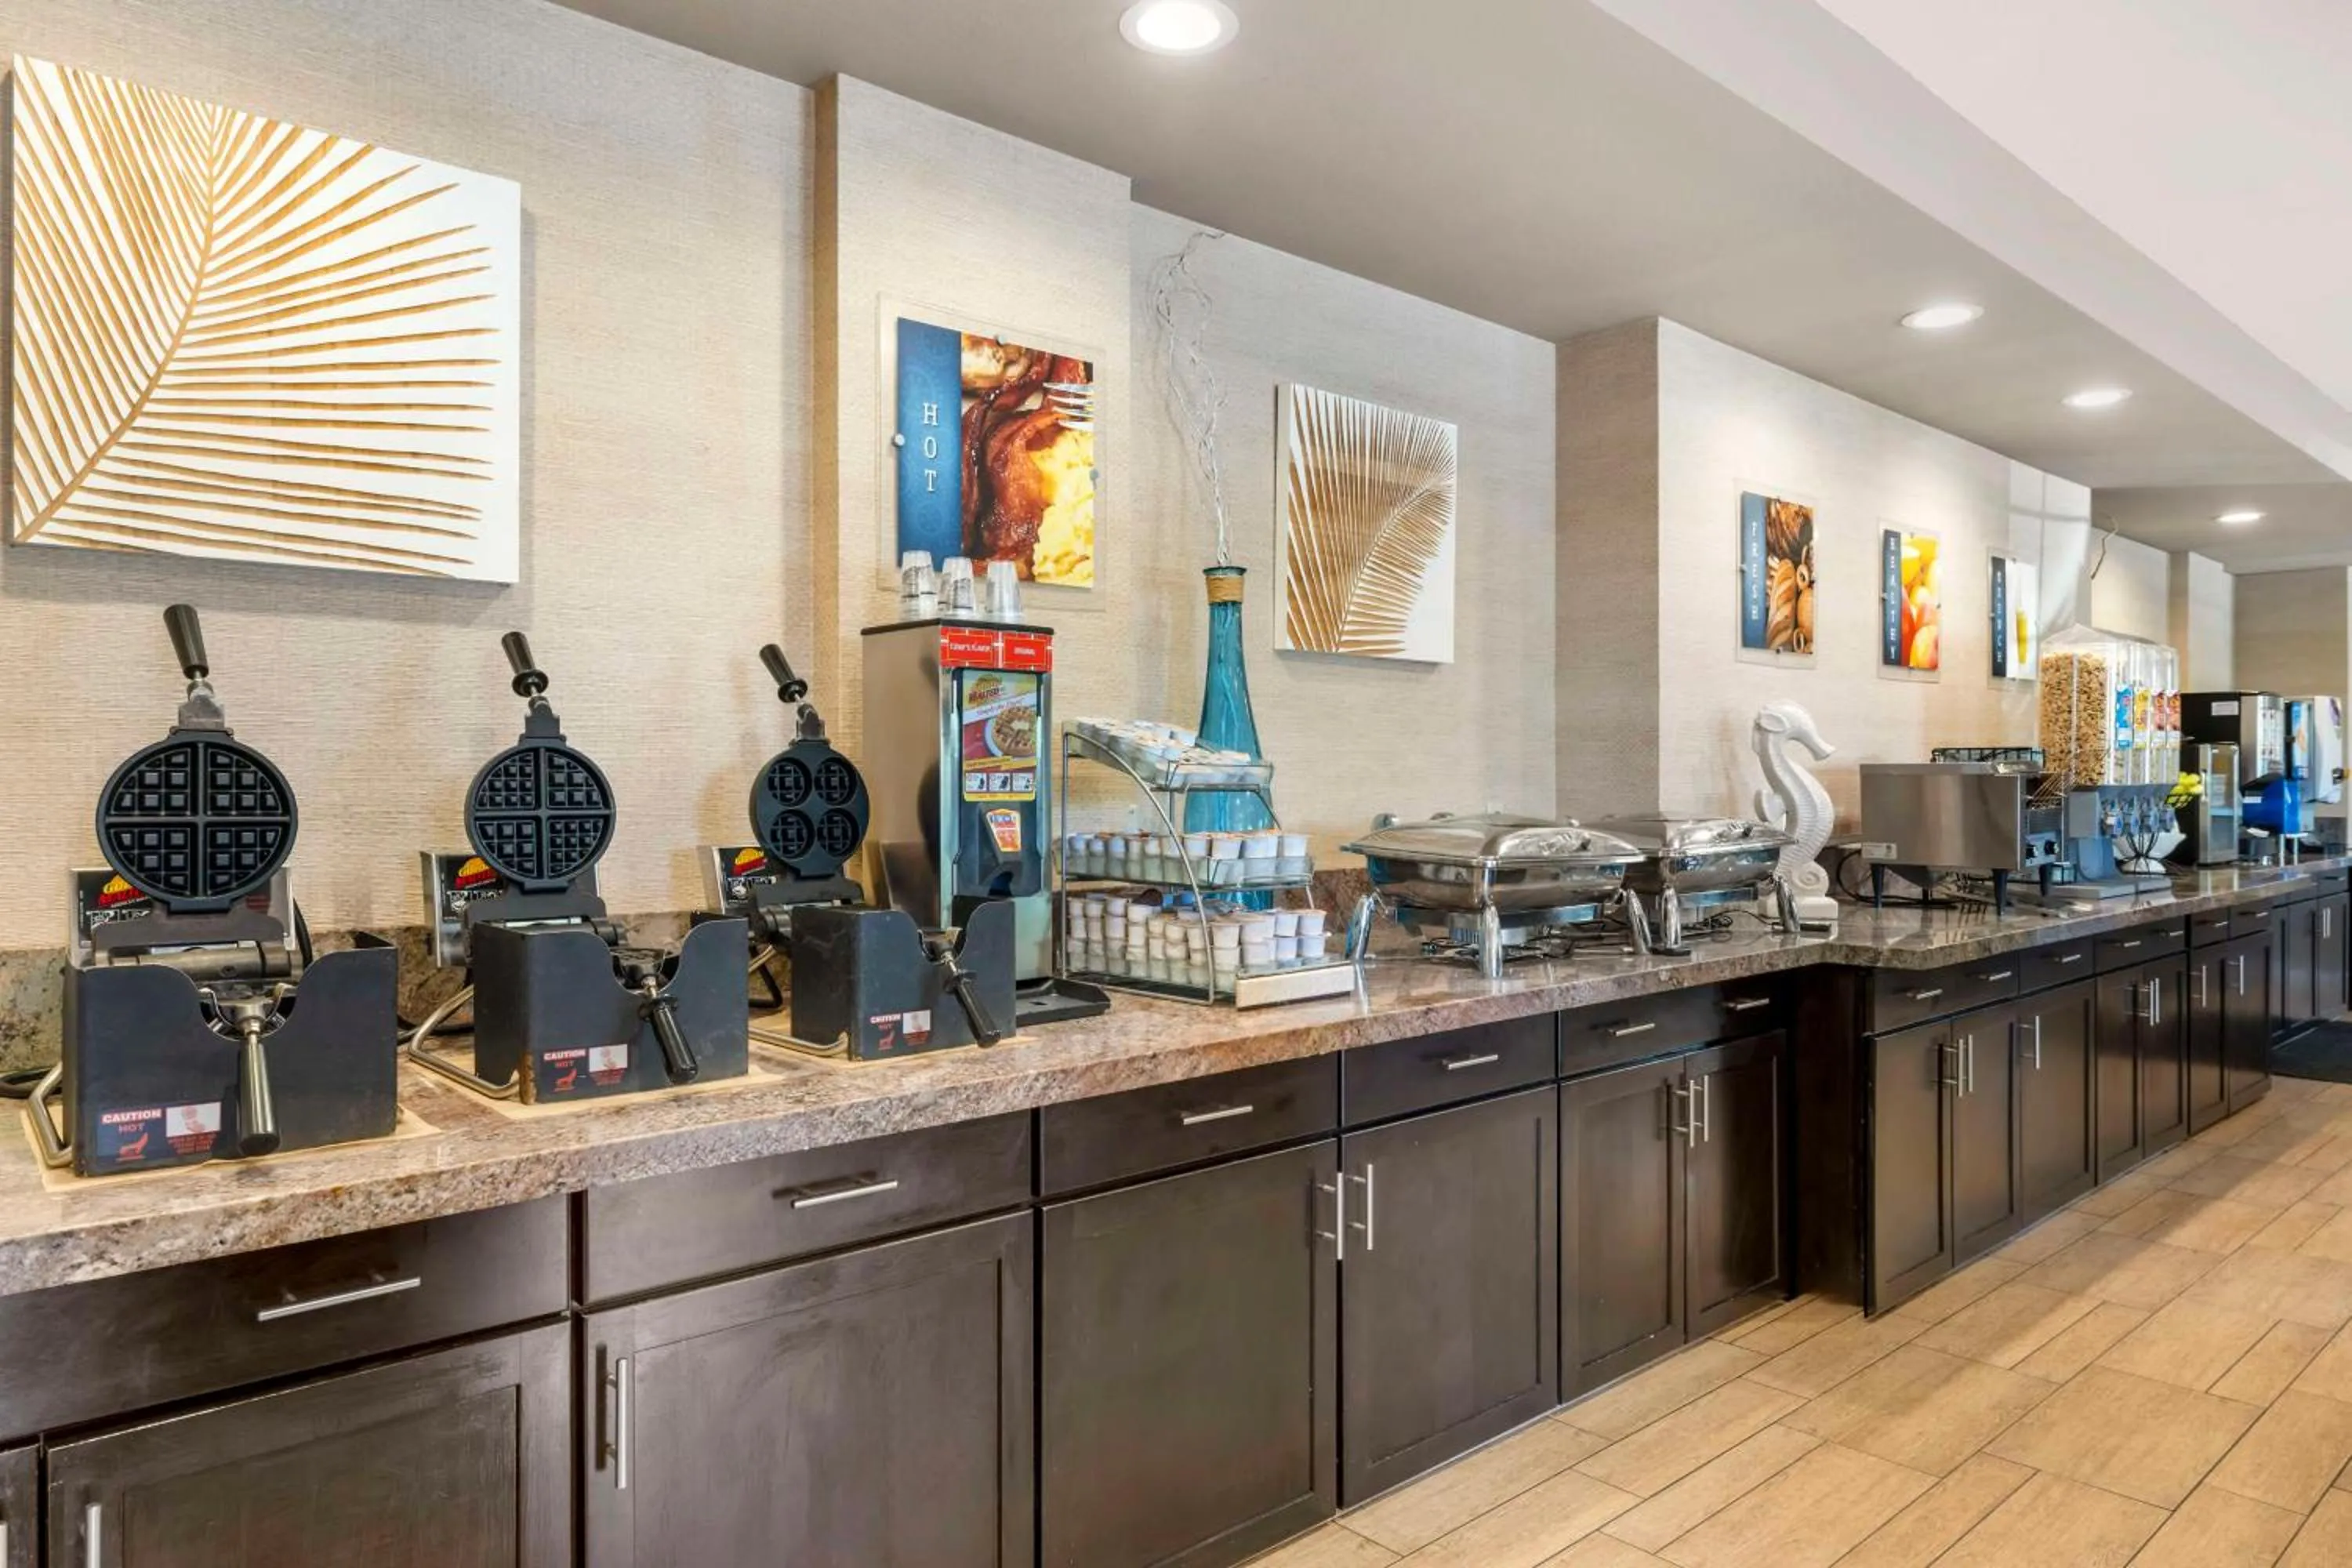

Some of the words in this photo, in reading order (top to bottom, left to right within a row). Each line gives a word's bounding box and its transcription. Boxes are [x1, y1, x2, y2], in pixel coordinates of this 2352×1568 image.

[923, 401, 938, 492] HOT
[544, 1049, 586, 1061] CAUTION
[101, 1108, 162, 1123] CAUTION
[118, 1123, 145, 1134] HOT
